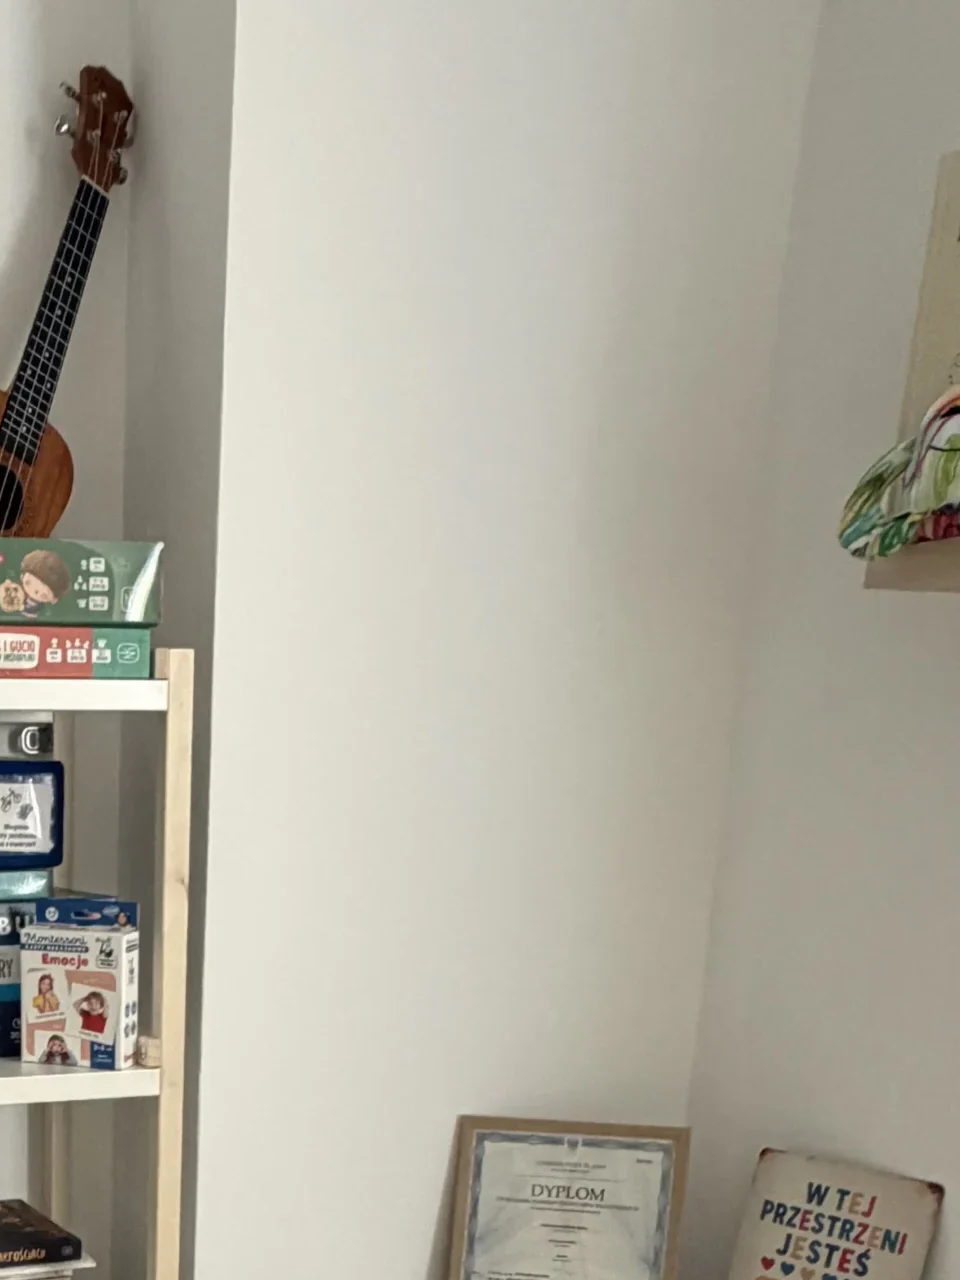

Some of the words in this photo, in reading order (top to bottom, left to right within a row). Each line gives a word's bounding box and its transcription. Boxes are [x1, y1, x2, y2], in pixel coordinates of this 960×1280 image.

[41, 953, 89, 969] Emocje
[531, 1183, 606, 1202] DYPLOM
[806, 1181, 830, 1206] W
[837, 1188, 878, 1218] TEJ
[760, 1199, 908, 1256] PRZESTRZENI
[775, 1233, 872, 1277] JESTEŚ
